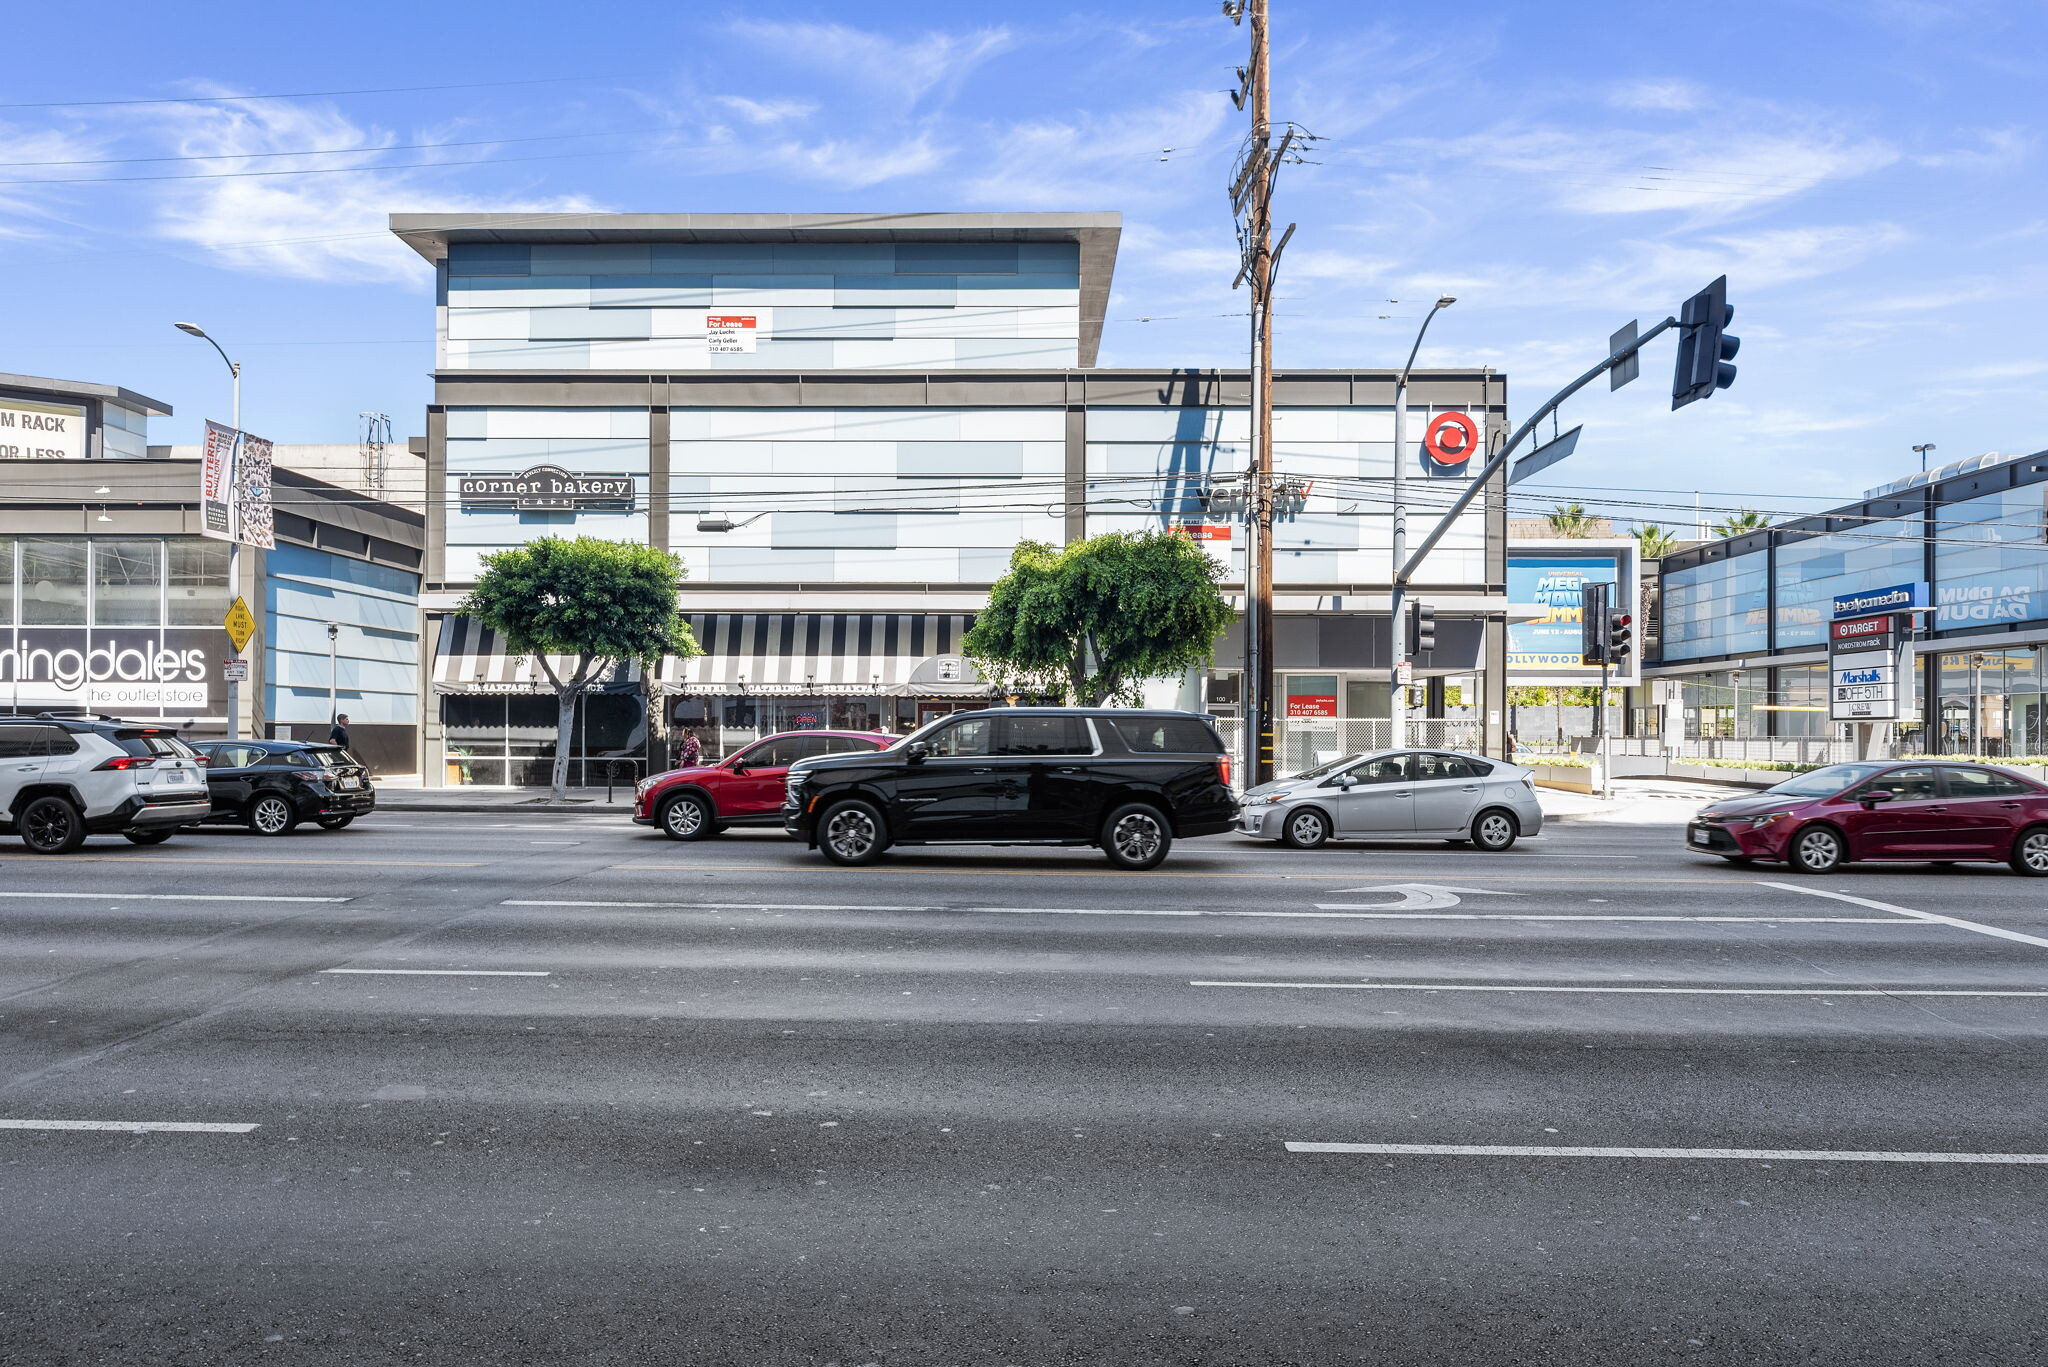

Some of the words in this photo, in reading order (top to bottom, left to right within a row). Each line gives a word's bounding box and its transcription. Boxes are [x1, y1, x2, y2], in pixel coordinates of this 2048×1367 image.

[21, 414, 66, 433] RACK
[205, 428, 217, 497] BUTTERFLY
[463, 480, 542, 495] corner
[550, 478, 628, 496] bakery
[522, 498, 570, 506] CAFE
[233, 621, 247, 629] MUST
[1848, 621, 1879, 635] TARGET
[1837, 640, 1867, 650] NORDSTROM
[1506, 655, 1580, 664] OLLYWOOD
[1839, 669, 1881, 684] Marshalls
[90, 688, 111, 702] he
[117, 688, 161, 702] outlet
[166, 688, 204, 702] store
[747, 684, 802, 693] CATERING
[1845, 686, 1864, 700] OFF
[1864, 685, 1883, 700] 5TH
[1848, 702, 1872, 716] J.CREW
